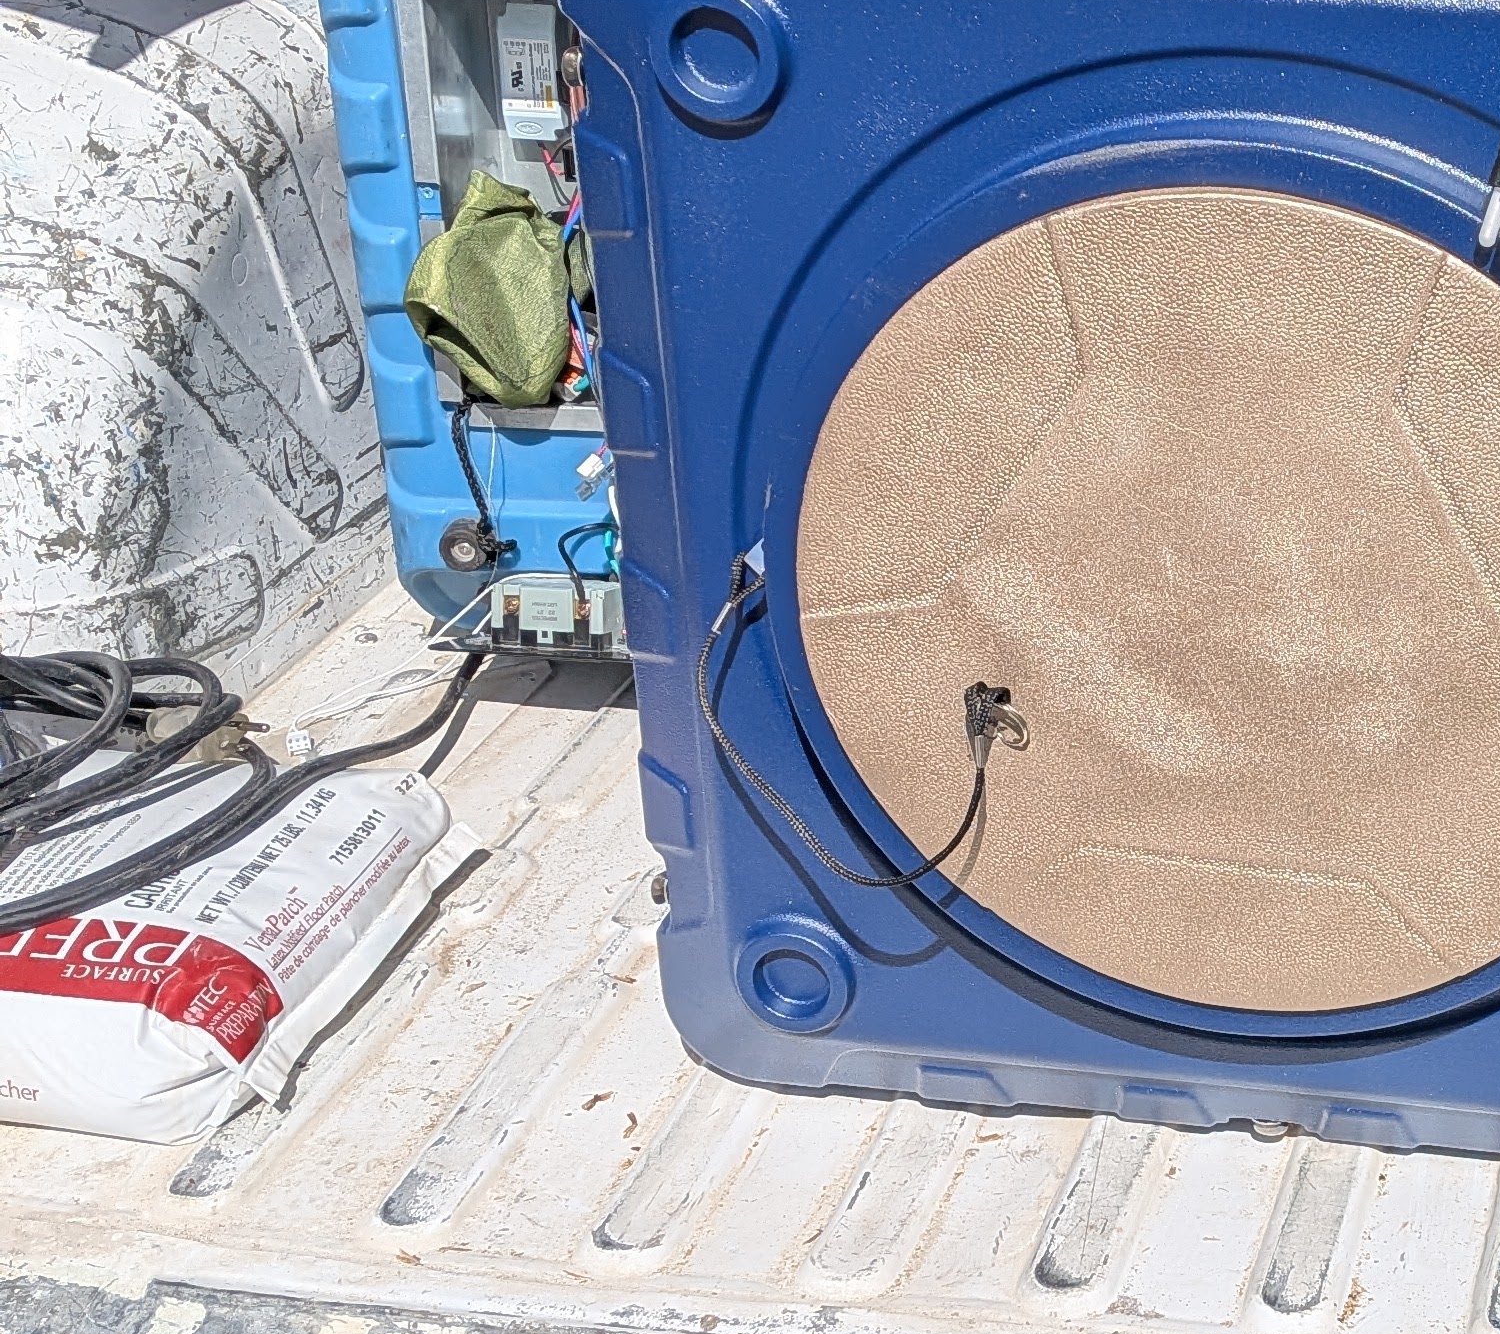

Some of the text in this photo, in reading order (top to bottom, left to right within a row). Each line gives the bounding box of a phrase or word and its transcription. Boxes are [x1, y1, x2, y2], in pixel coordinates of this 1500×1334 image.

[394, 773, 419, 796] 327
[329, 808, 386, 866] 7155813011
[195, 904, 222, 925] NET
[258, 843, 283, 864] NET
[271, 834, 289, 849] 25
[280, 823, 306, 845] LBS.
[295, 797, 325, 825] 11.34
[315, 787, 337, 805] KG
[154, 879, 189, 912] IRRITANT
[278, 964, 296, 983] Pâte
[293, 954, 305, 967] de
[329, 912, 342, 927] de
[339, 885, 367, 919] plancher
[365, 858, 392, 890] modifiée
[394, 835, 412, 855] latex
[266, 884, 346, 970] Latex Modified Floor Patch
[61, 963, 165, 984] SURFACE
[190, 972, 228, 1012] TEC
[206, 1000, 237, 1032] SURFACE
[0, 1080, 40, 1102] cher
